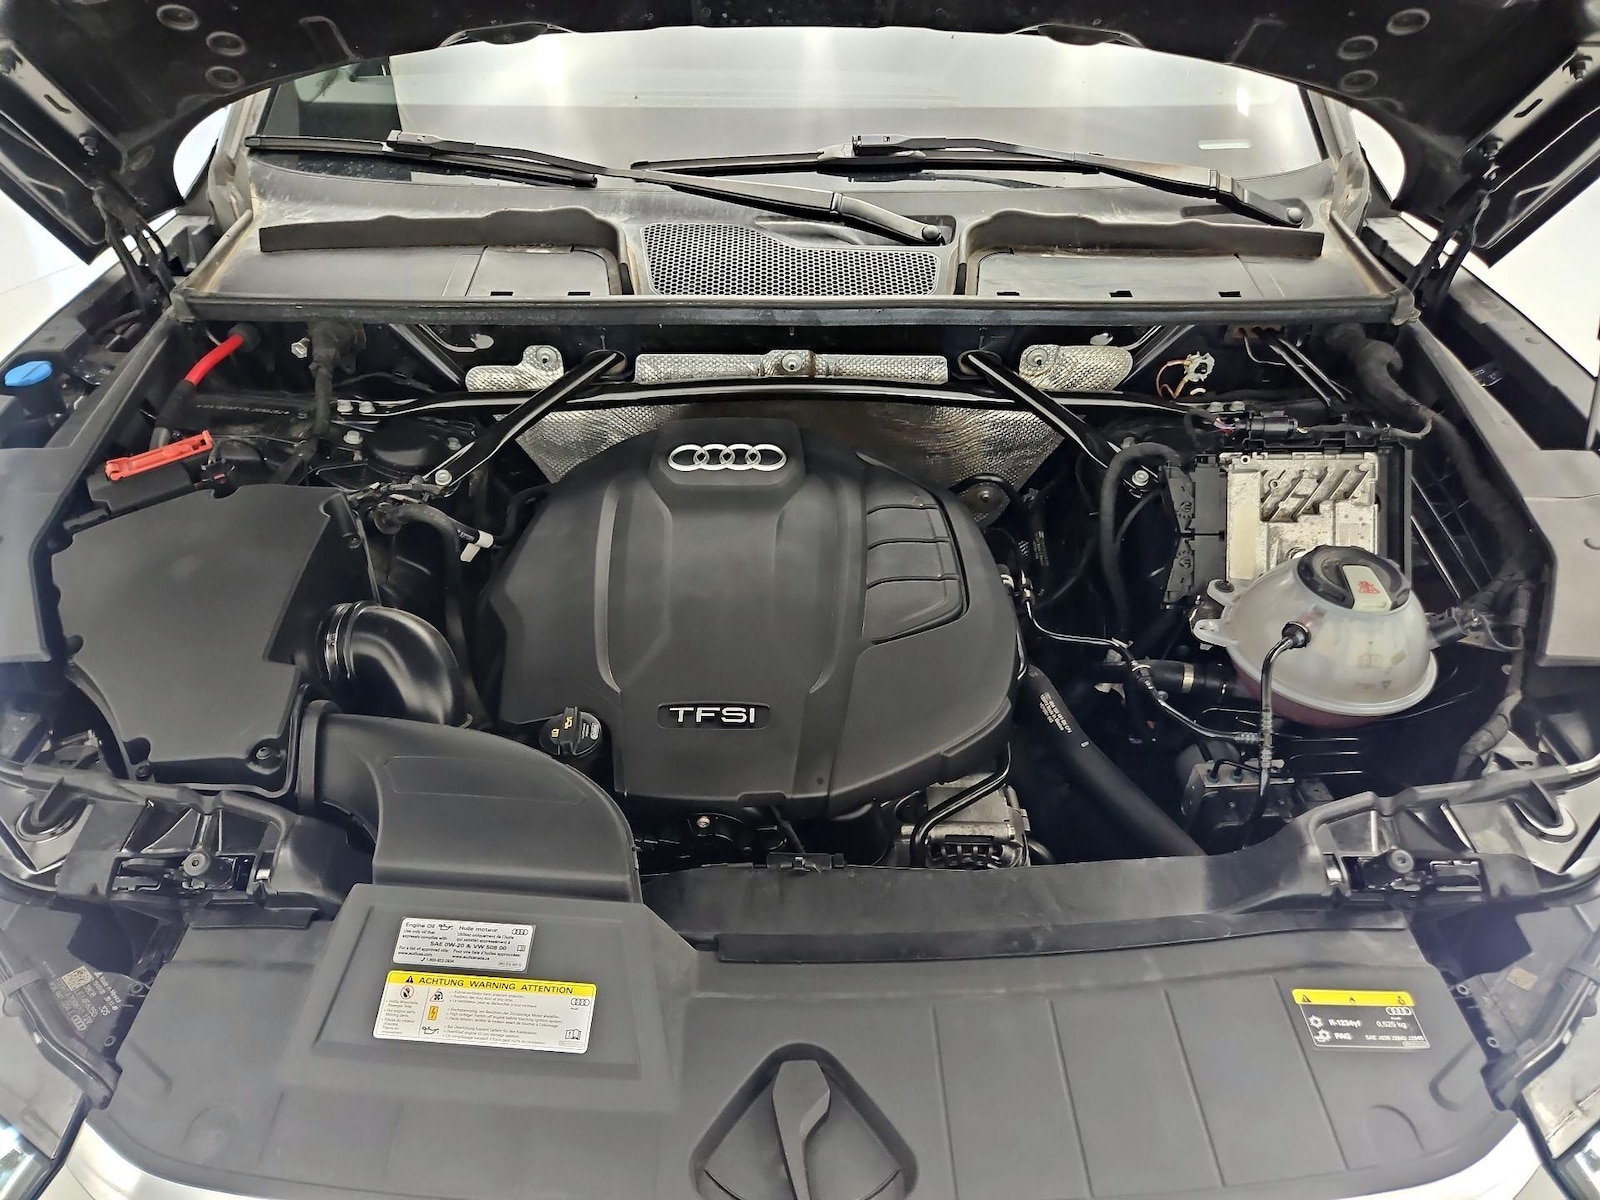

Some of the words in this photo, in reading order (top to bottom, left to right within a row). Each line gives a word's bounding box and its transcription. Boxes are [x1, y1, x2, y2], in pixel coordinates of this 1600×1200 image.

[669, 707, 755, 724] TFSI
[418, 976, 464, 986] ACHTUNG
[469, 980, 516, 990] WARNING
[520, 983, 573, 994] ATTENTION
[1397, 1020, 1407, 1029] kg
[1334, 1032, 1352, 1040] PAG
